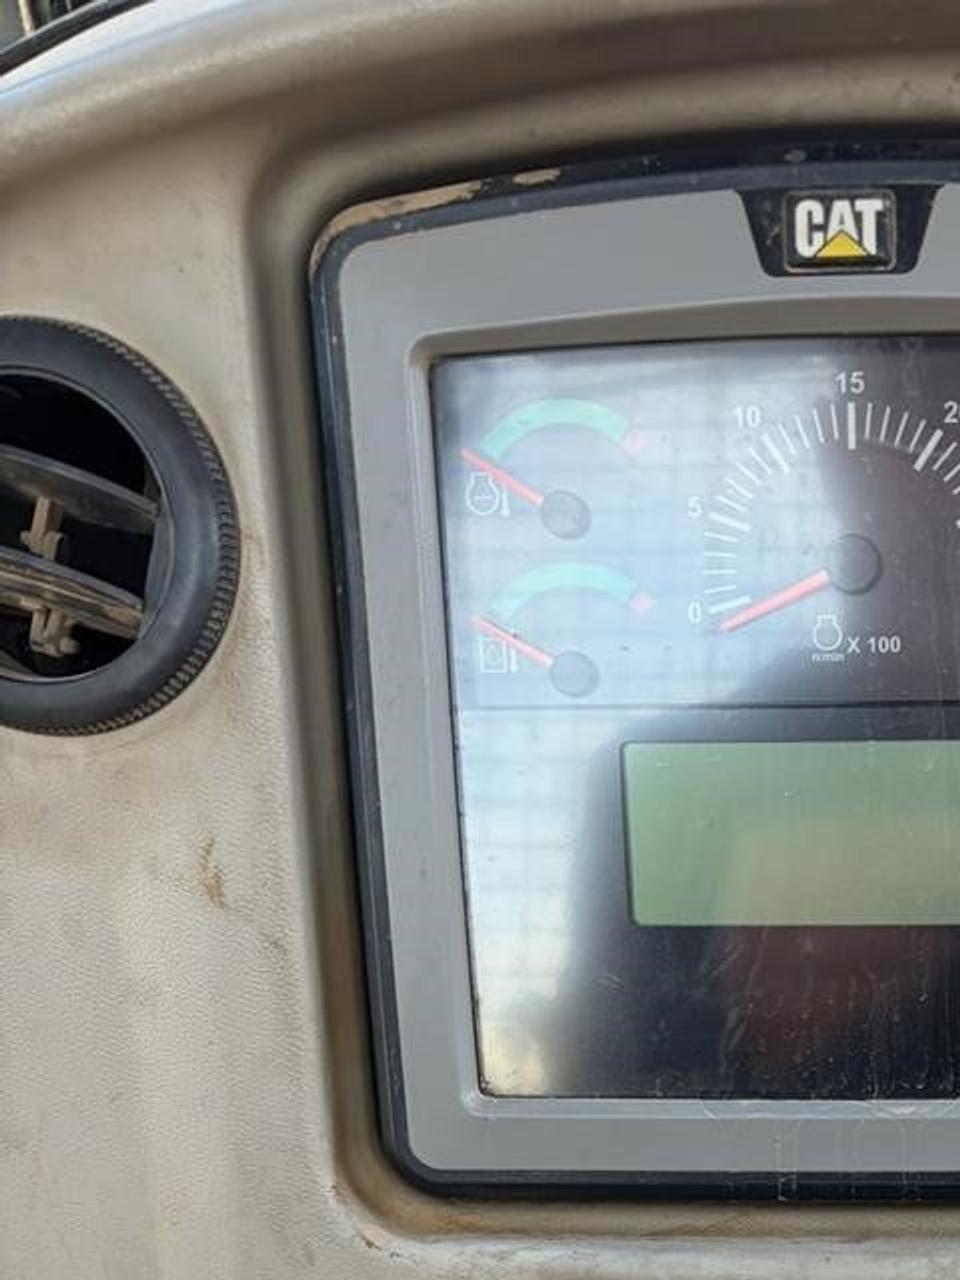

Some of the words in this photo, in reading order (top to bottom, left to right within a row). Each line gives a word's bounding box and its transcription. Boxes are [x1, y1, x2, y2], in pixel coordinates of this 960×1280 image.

[795, 198, 883, 258] CAT
[835, 371, 865, 394] 15
[733, 405, 761, 428] 10
[687, 496, 702, 518] 5
[688, 602, 702, 625] 0
[867, 635, 902, 653] 100
